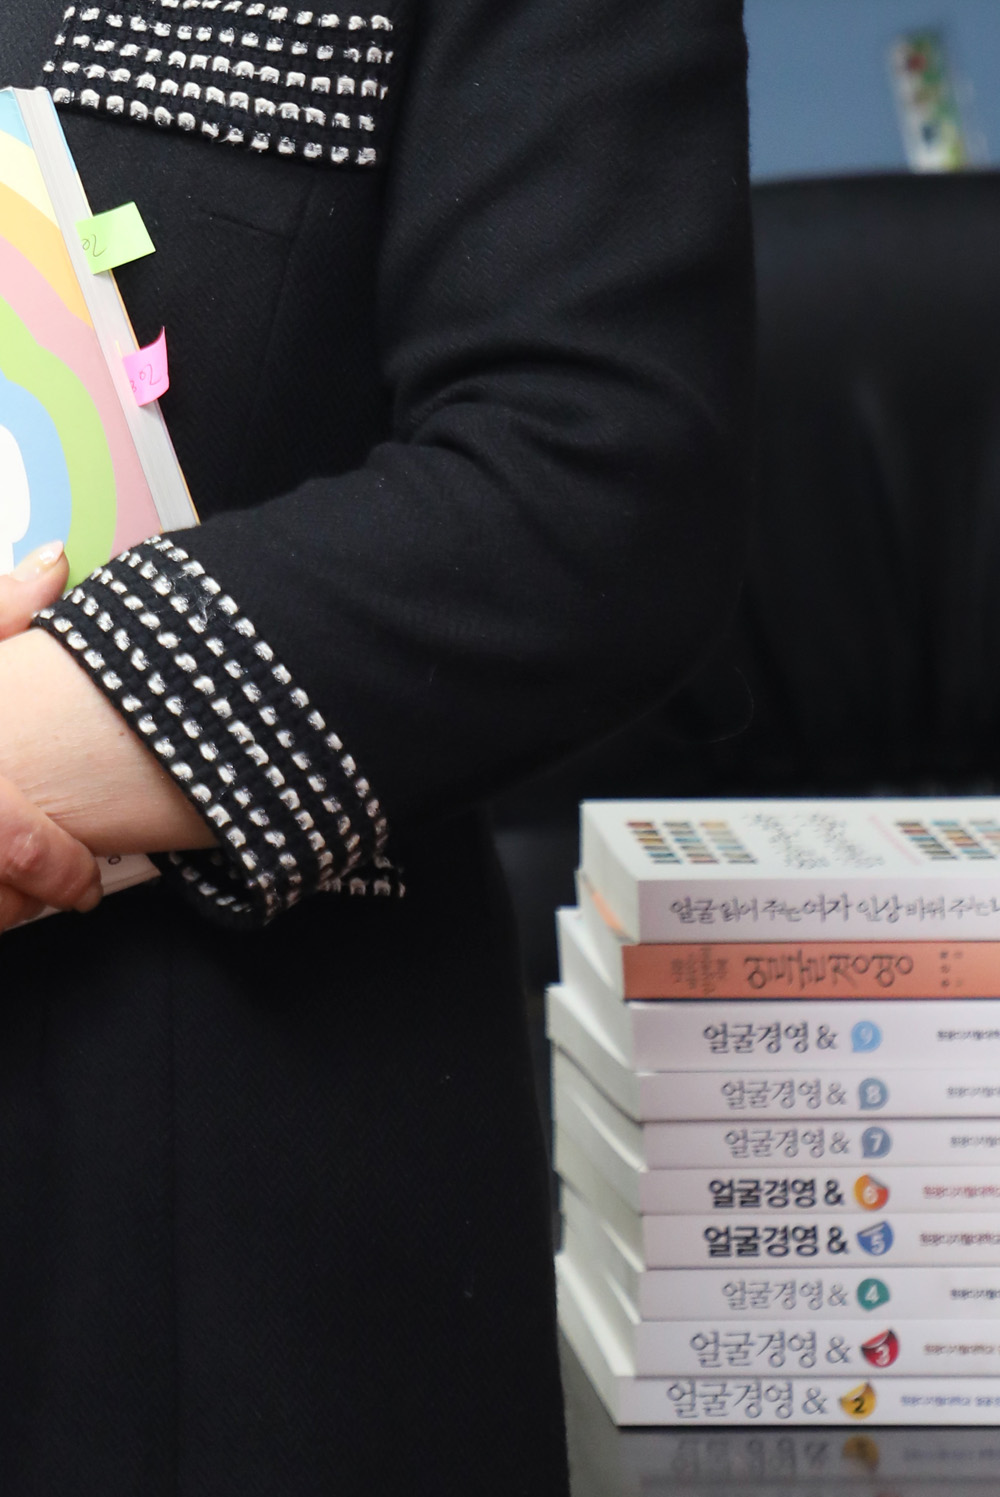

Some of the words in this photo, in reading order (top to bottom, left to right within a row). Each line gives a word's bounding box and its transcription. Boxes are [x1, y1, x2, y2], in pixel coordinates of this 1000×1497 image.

[703, 1020, 809, 1054] 얼굴경영
[816, 1024, 839, 1050] &
[721, 1078, 822, 1110] 얼굴경영
[826, 1081, 847, 1105] &
[724, 1127, 825, 1159] 얼굴경영
[829, 1131, 850, 1155] &
[708, 1178, 817, 1209] 얼굴경영
[824, 1179, 845, 1206] &
[703, 1224, 819, 1258] 얼굴경영
[827, 1226, 849, 1255] &
[721, 1278, 824, 1311] 얼굴경영
[827, 1283, 849, 1306] &
[689, 1329, 818, 1368] 얼굴경영
[825, 1335, 852, 1365] &
[666, 1378, 794, 1419] 얼굴경영
[802, 1386, 829, 1415] &
